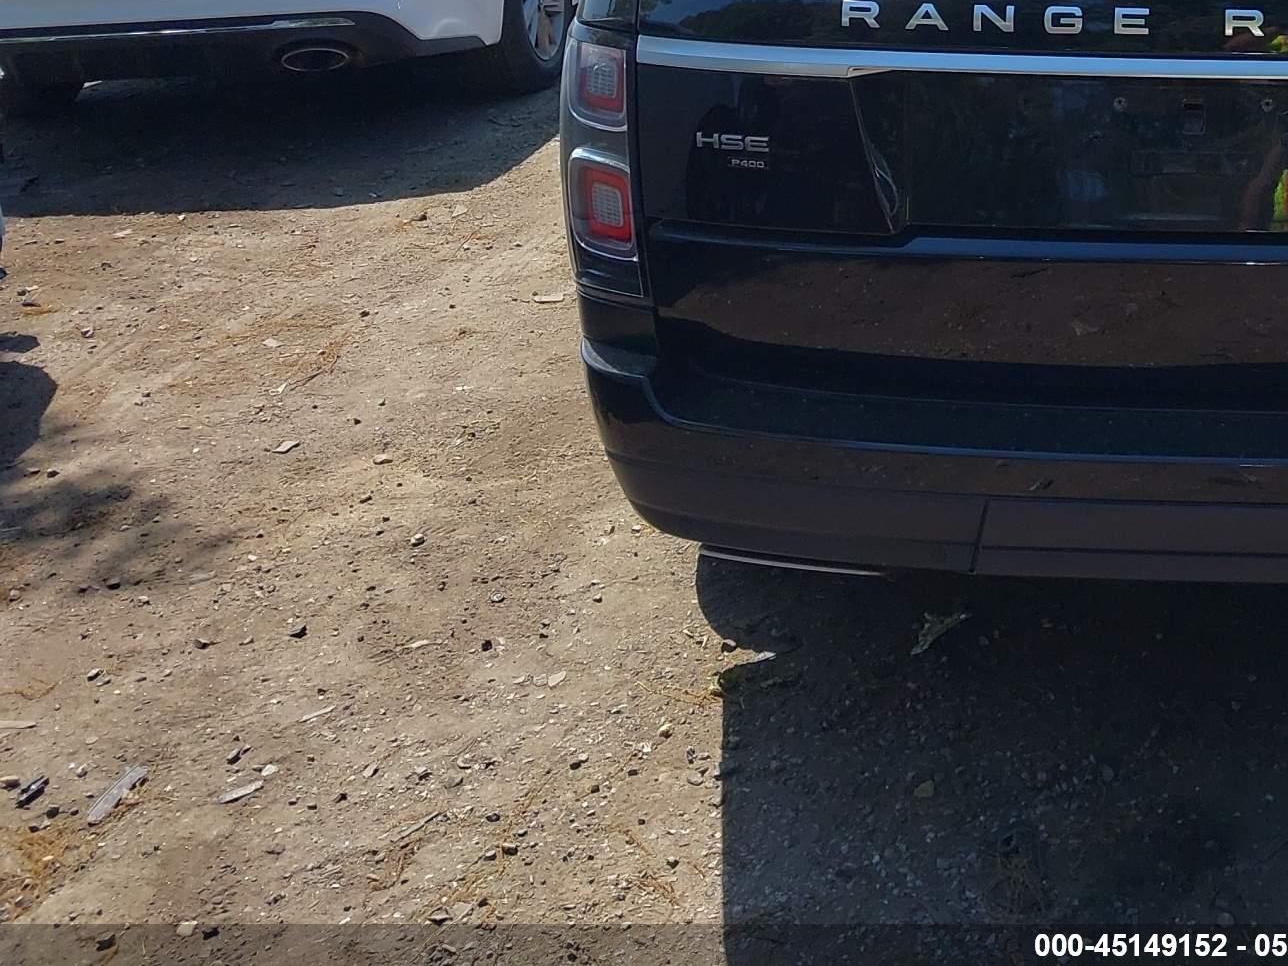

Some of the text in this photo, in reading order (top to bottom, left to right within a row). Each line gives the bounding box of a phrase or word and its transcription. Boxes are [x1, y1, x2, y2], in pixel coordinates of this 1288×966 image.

[841, 0, 1150, 35] RANGE
[696, 131, 769, 152] HSE
[731, 159, 765, 168] P400
